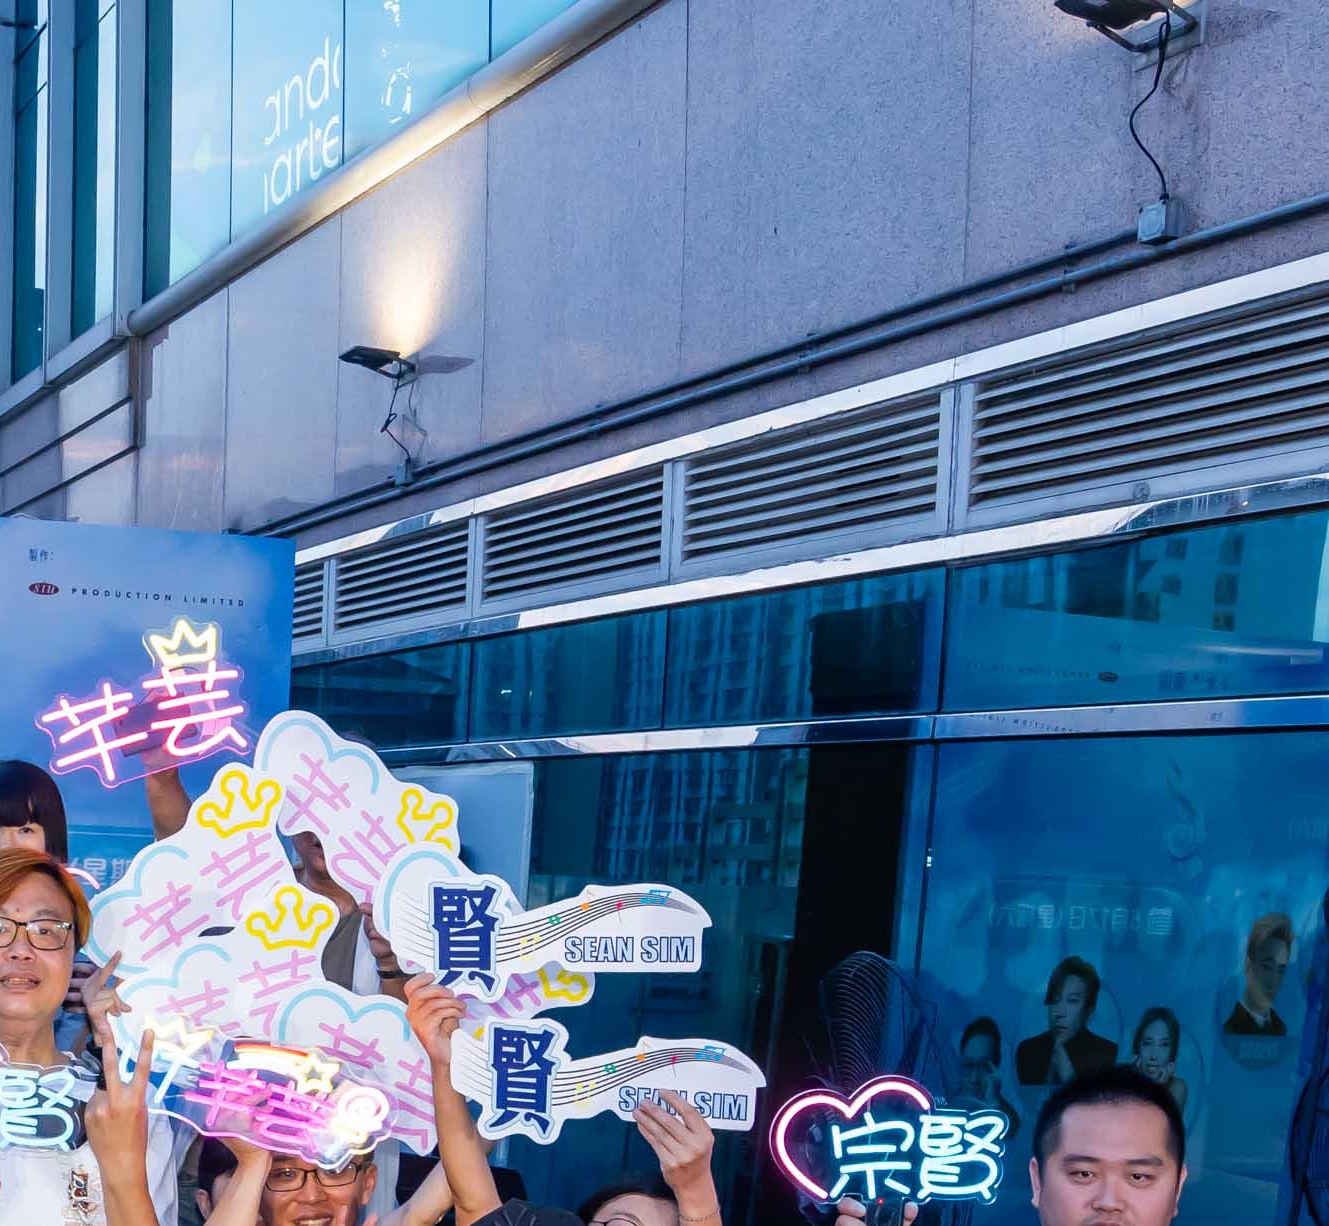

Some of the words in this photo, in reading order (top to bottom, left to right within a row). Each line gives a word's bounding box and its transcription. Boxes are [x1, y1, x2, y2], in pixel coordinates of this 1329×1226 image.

[71, 587, 173, 601] PRODUCTION
[184, 595, 246, 608] LIMITED
[430, 885, 497, 1001] 賢
[564, 936, 634, 964] SEAN
[642, 936, 695, 963] SIM
[488, 1025, 561, 1142] 賢
[694, 1091, 748, 1121] SIM
[829, 1109, 1007, 1204] 宗賢
